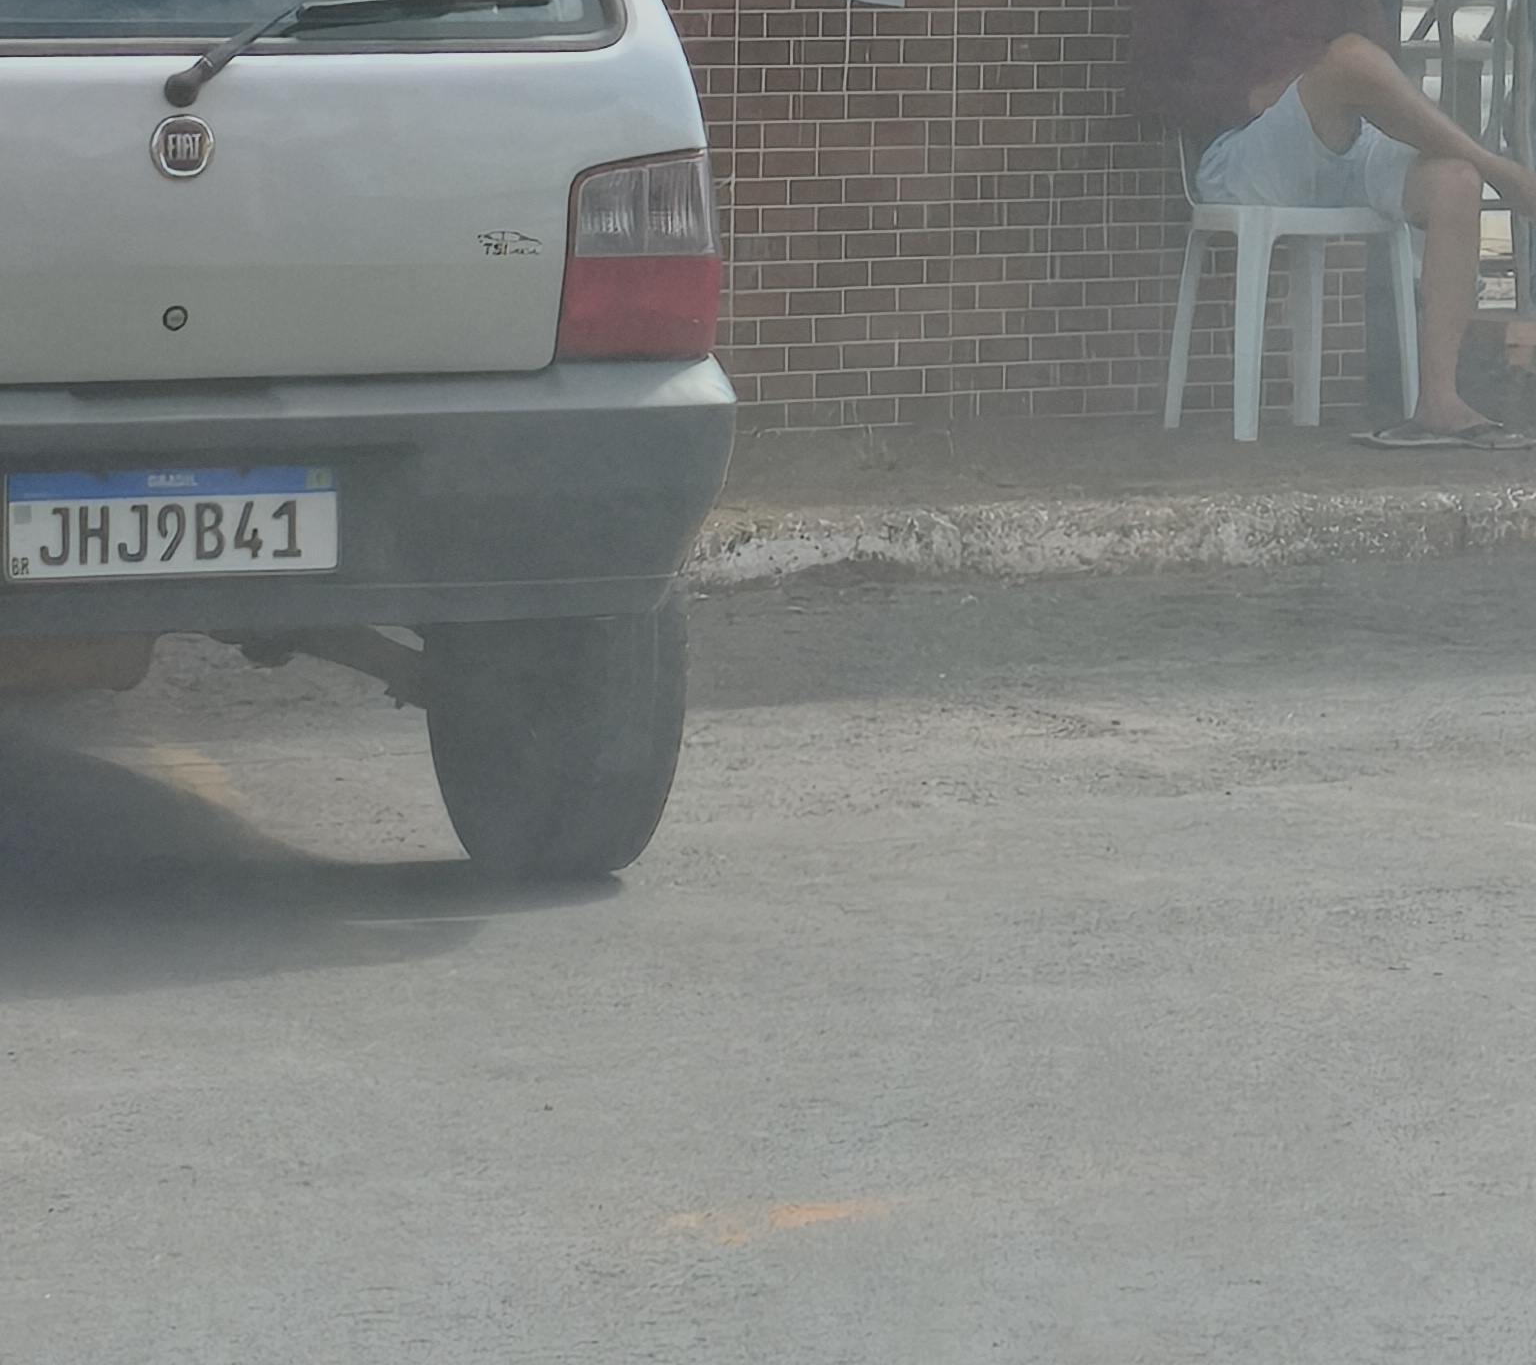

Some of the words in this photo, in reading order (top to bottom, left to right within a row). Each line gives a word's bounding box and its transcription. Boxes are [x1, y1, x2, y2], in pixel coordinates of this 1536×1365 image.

[167, 133, 202, 160] FIAT
[39, 499, 302, 566] JHJ9B41
[11, 557, 30, 576] BR
